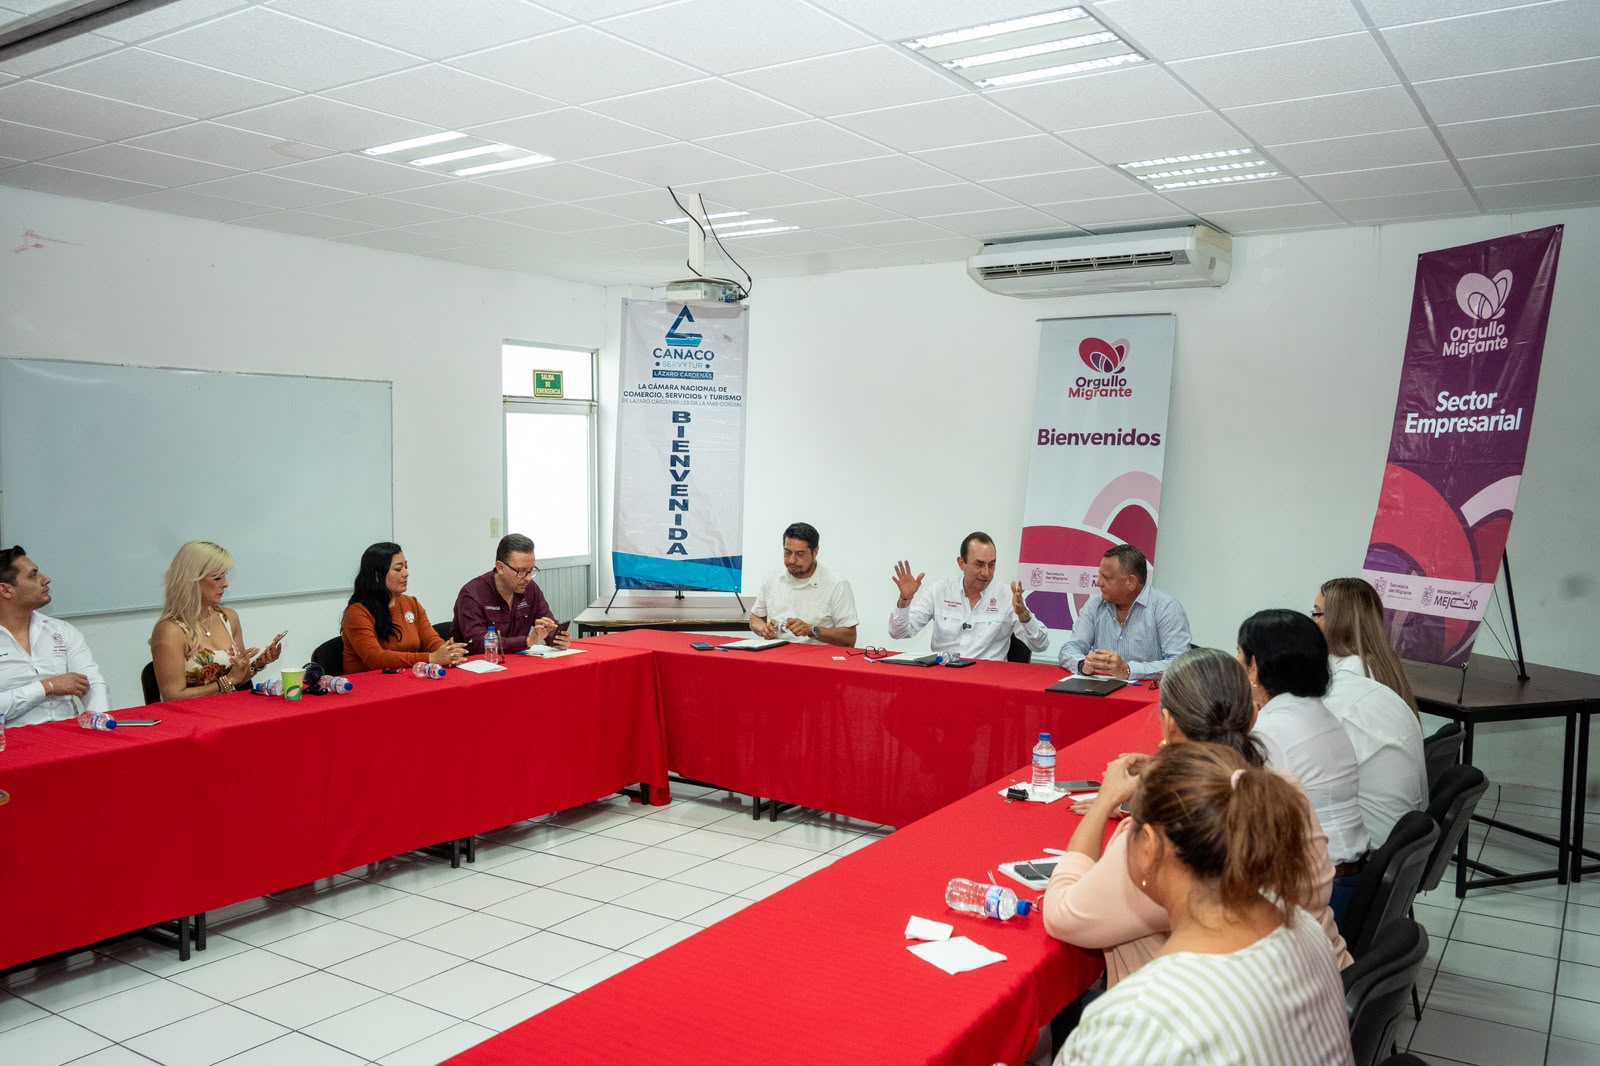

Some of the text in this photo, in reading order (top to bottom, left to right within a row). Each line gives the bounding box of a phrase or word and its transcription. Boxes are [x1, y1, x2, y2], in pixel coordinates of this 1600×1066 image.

[1450, 321, 1505, 343] Orgullo
[653, 348, 715, 361] CANACO
[1442, 337, 1508, 358] Migrante
[662, 361, 703, 369] SERVYTUR
[1075, 375, 1127, 389] Orgullo
[1068, 387, 1132, 400] Migrante
[1435, 391, 1497, 412] Sector
[1405, 408, 1522, 438] Empresarial
[1037, 428, 1161, 446] Bienvenidos
[666, 411, 692, 555] BIENVENIDA
